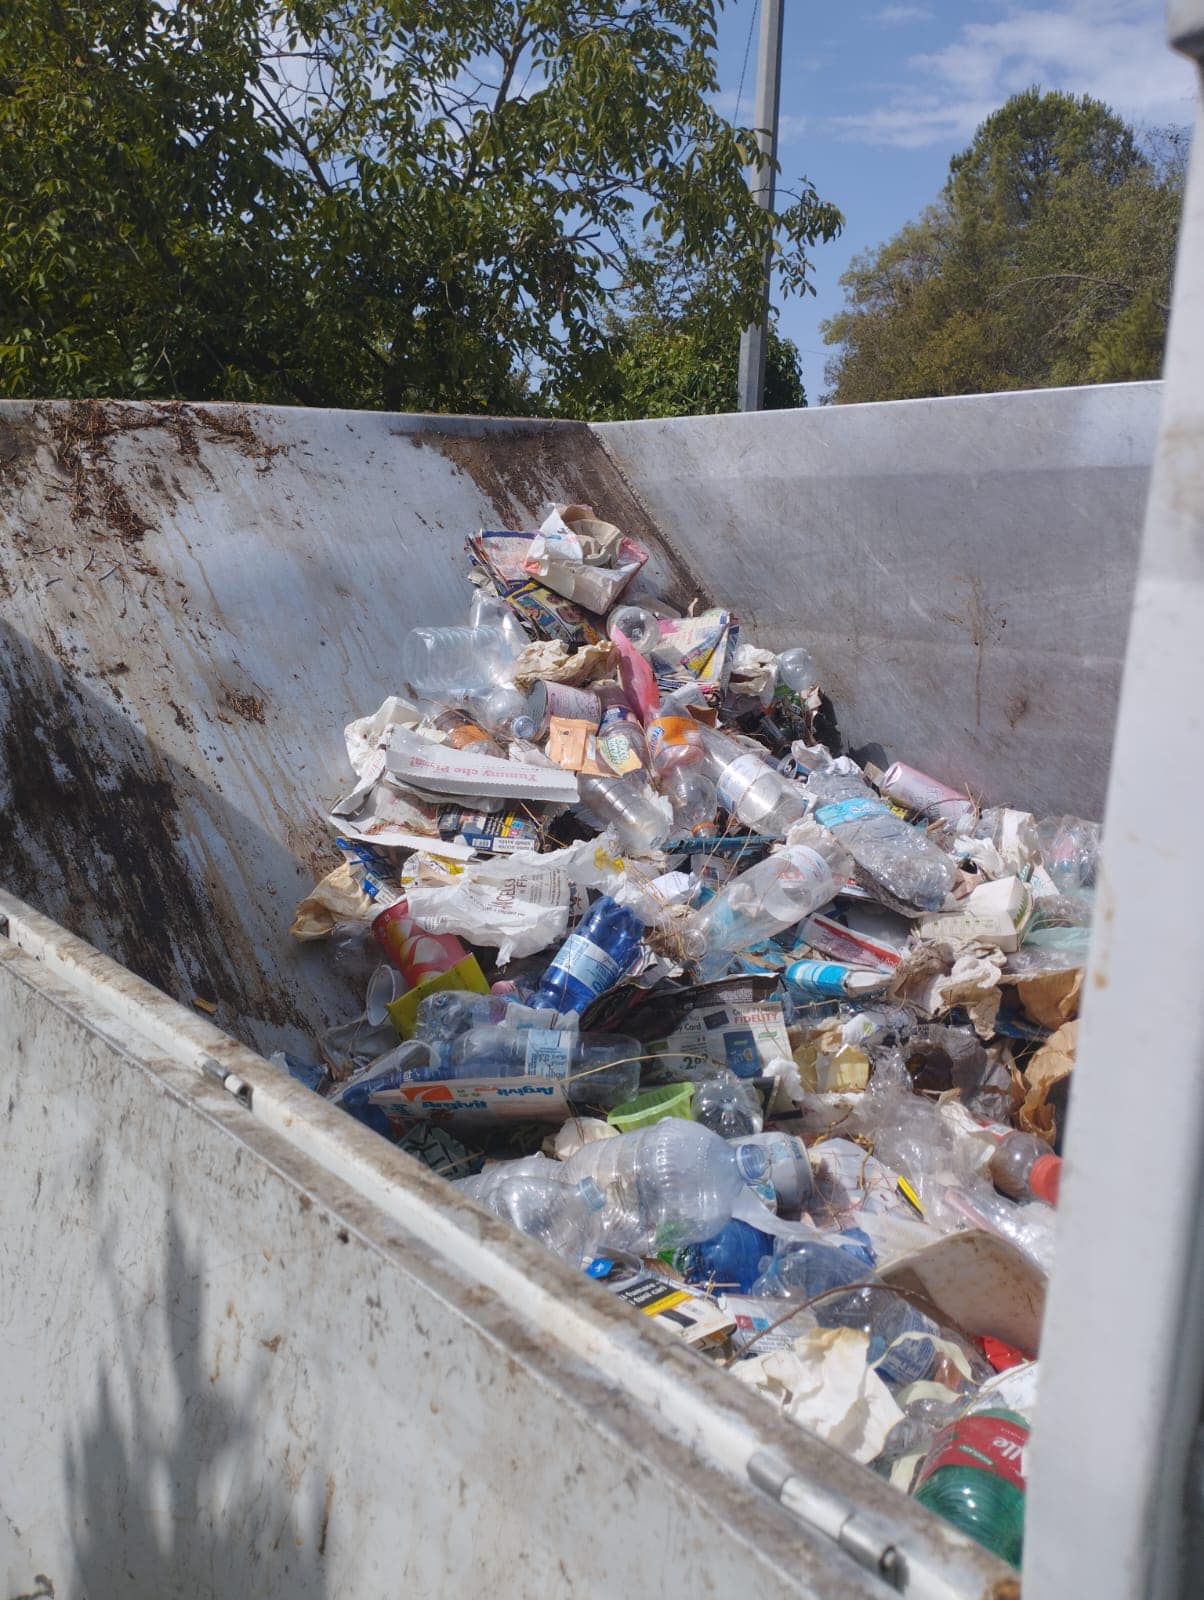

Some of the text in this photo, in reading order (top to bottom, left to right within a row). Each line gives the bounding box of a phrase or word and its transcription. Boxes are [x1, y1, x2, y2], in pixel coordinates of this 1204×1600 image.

[453, 765, 479, 775] che
[482, 769, 538, 783] Yummy
[733, 1011, 778, 1025] FIDELITY
